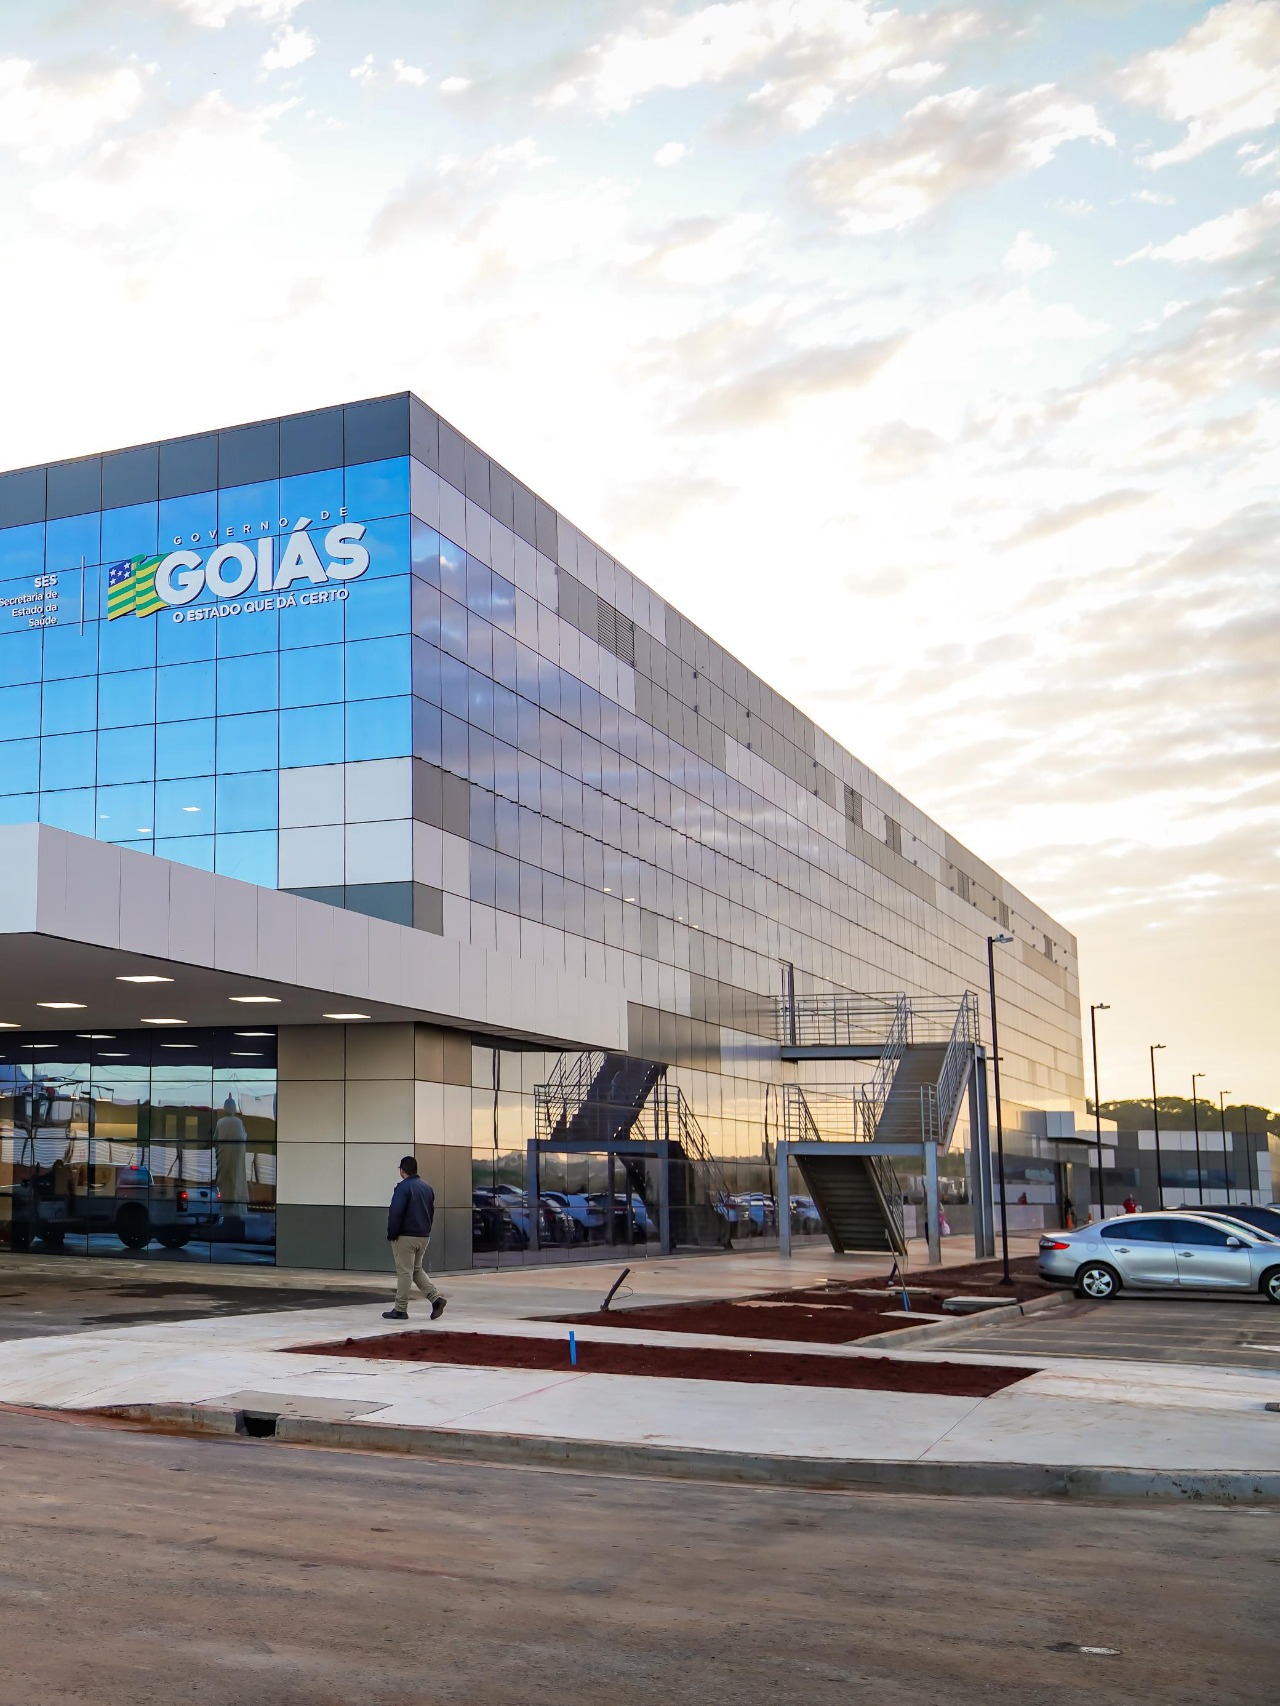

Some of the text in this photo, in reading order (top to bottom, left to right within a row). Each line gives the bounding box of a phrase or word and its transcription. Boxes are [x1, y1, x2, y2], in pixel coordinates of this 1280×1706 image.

[173, 507, 349, 546] GOVERNO DE
[154, 516, 370, 605] GOIÁS
[34, 574, 58, 588] SES
[45, 590, 58, 600] de
[12, 603, 58, 618] Estado da
[172, 588, 350, 623] O ESTADO QUE DÁ CERTO
[28, 615, 57, 627] Saúde
